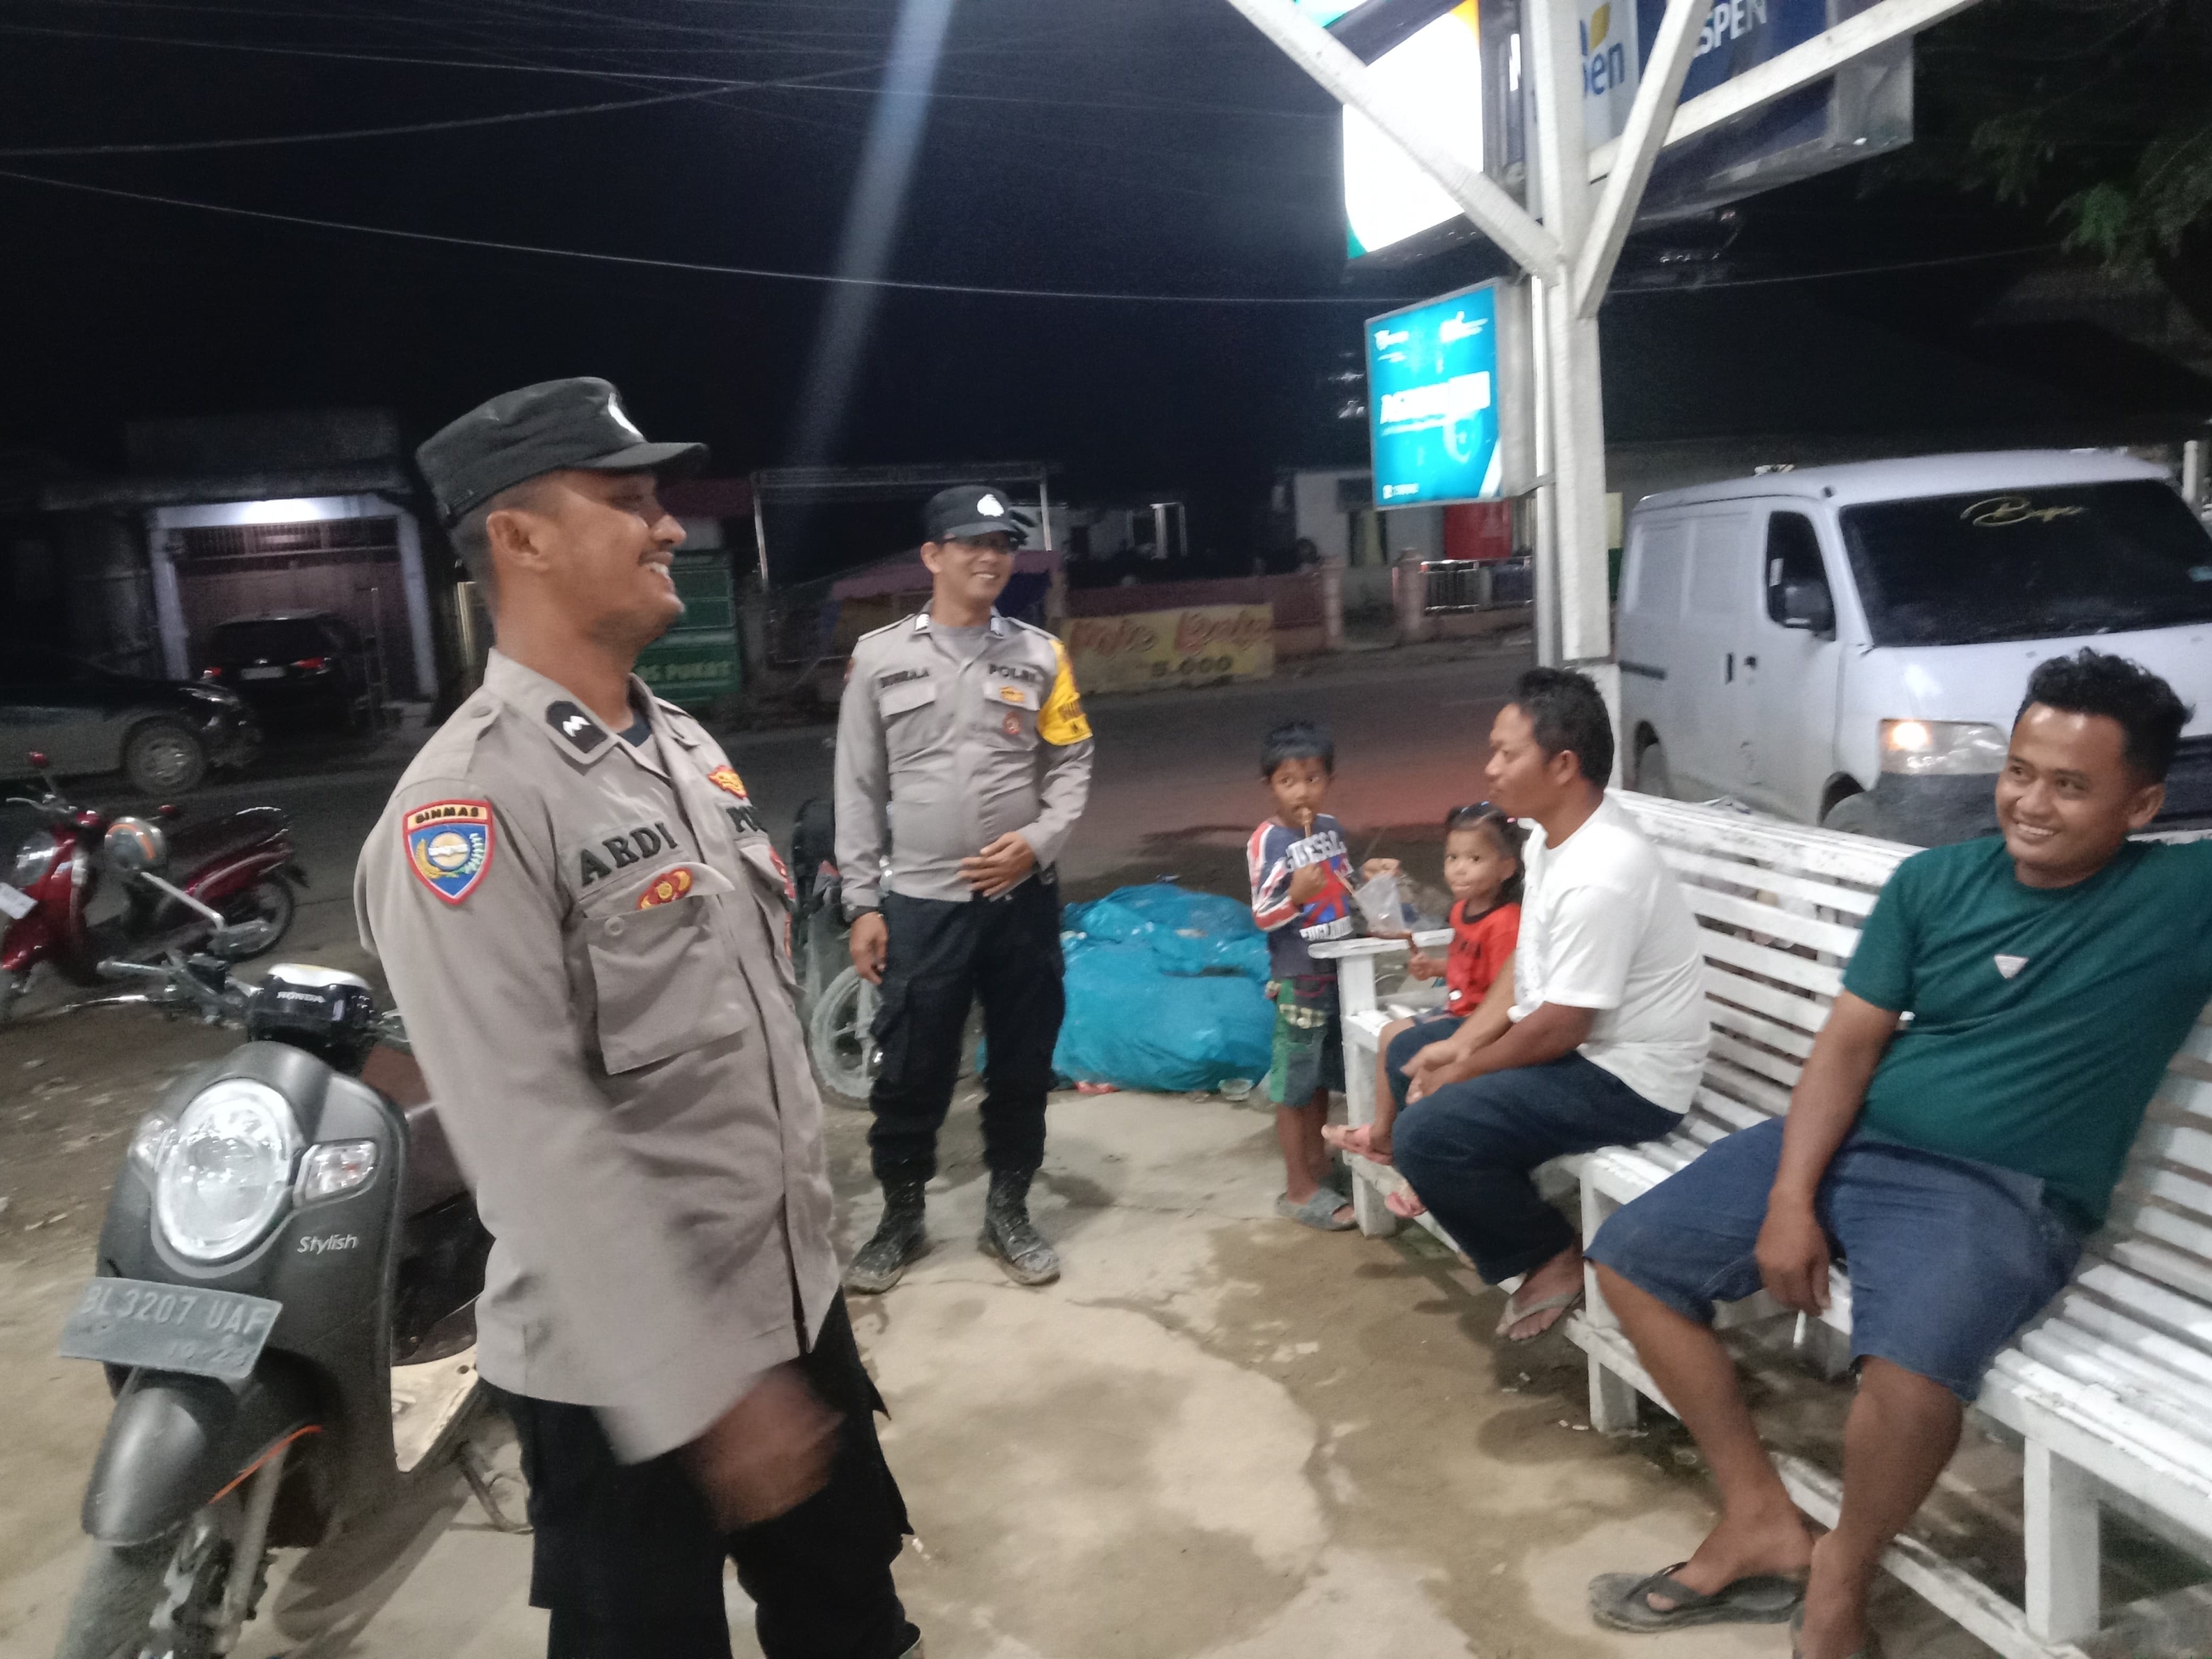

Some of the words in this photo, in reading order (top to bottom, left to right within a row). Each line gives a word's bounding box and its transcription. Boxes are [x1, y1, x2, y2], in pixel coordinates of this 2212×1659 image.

[415, 806, 480, 824] BINMAS
[580, 821, 678, 887] ARDI
[276, 991, 326, 1003] HONDA
[297, 1234, 359, 1255] Stylish
[79, 1285, 112, 1316] BL
[118, 1288, 196, 1326] 3207
[207, 1299, 273, 1335] UAF
